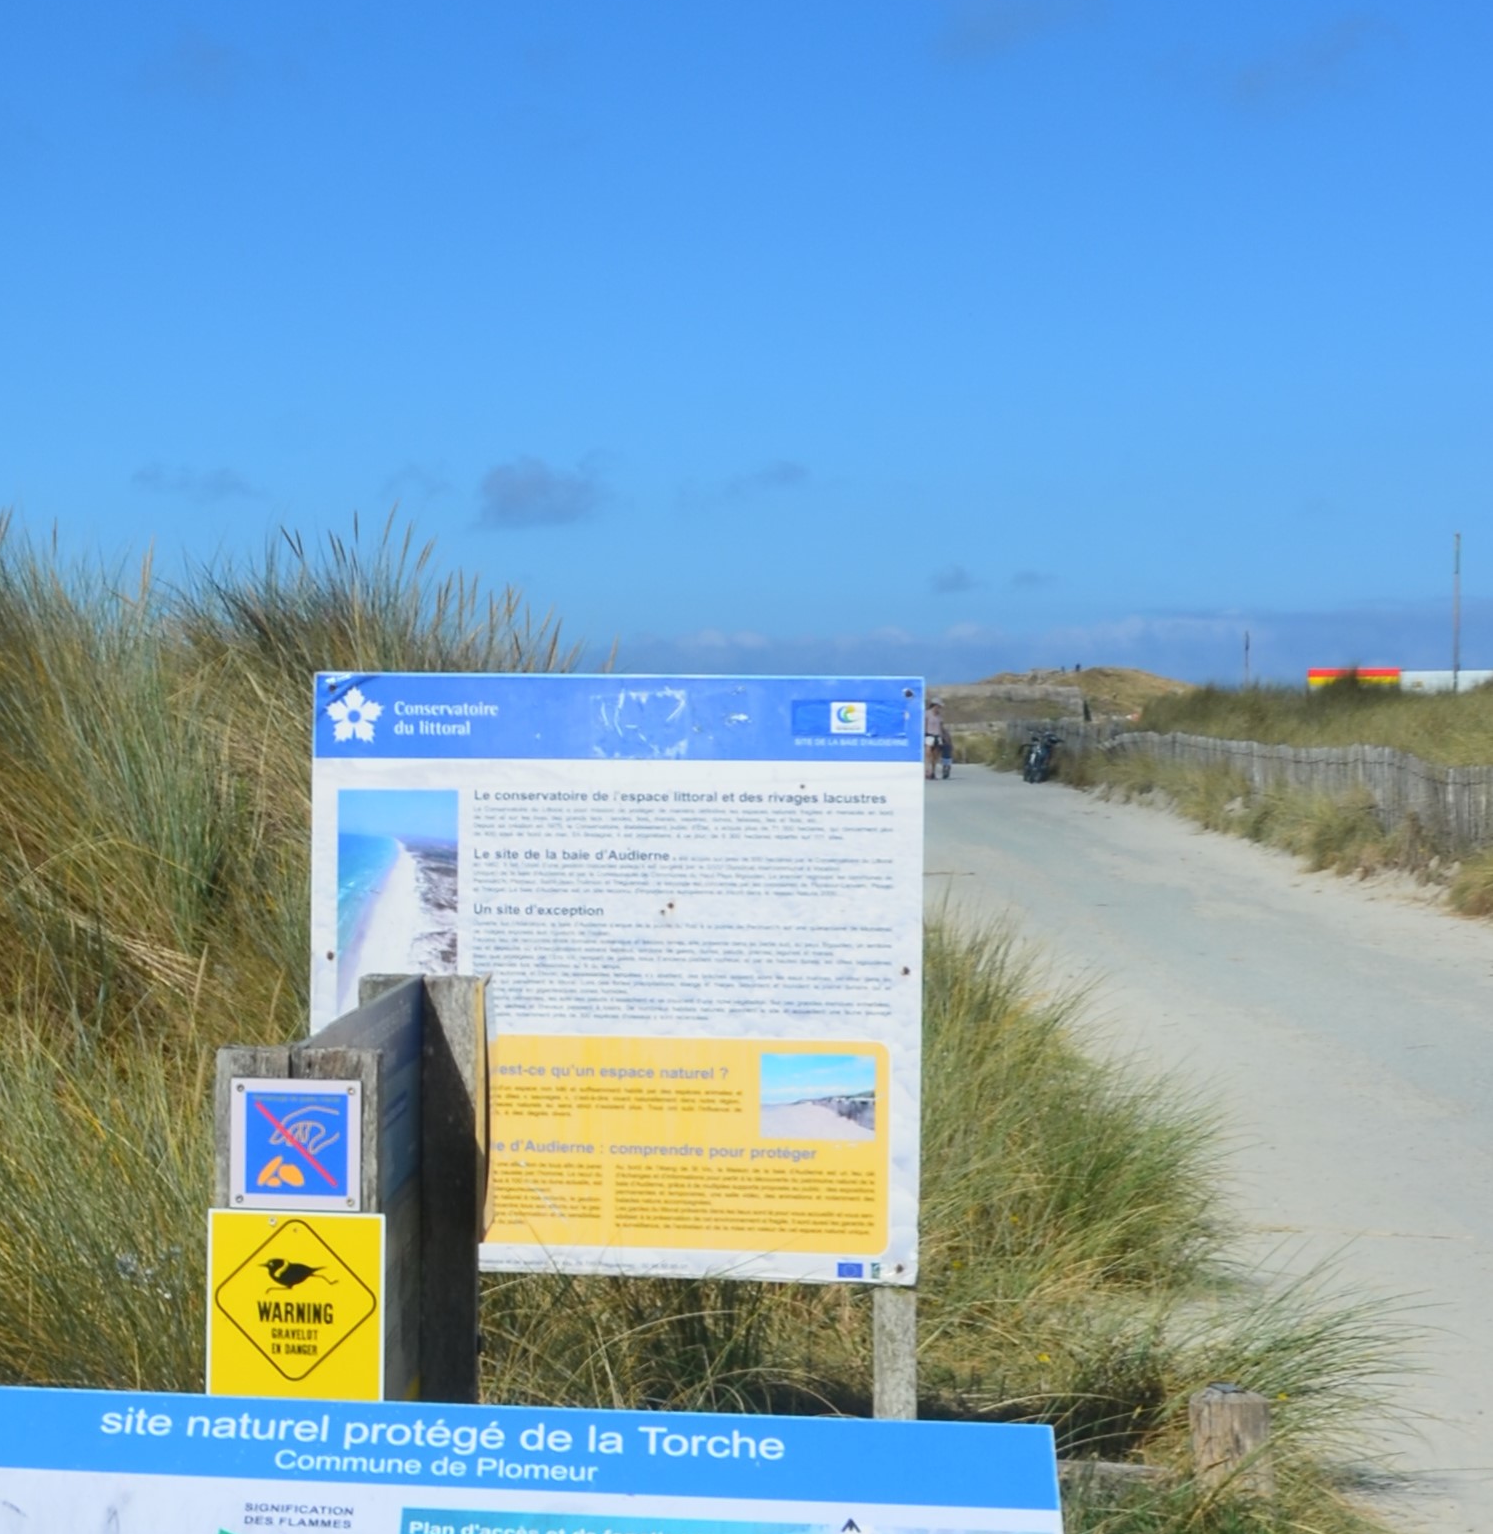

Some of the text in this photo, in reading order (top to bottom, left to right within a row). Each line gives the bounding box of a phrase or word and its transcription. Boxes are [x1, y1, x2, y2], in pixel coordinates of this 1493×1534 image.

[394, 701, 498, 716] Conservatoire
[394, 720, 470, 735] du littoral
[474, 789, 490, 800] Le
[494, 791, 588, 801] conservatoire
[592, 791, 608, 801] de
[674, 791, 717, 802] littoral
[721, 792, 734, 802] et
[738, 792, 763, 803] des
[767, 793, 818, 806] rivages
[823, 792, 887, 804] lacustres
[473, 848, 490, 859] Le
[495, 849, 518, 859] site
[524, 849, 540, 860] de
[545, 849, 557, 860] la
[562, 850, 589, 860] baie
[594, 850, 669, 861] d'Audierne
[473, 903, 604, 917] Un site d'exception
[551, 1066, 595, 1078] qu'un
[599, 1067, 655, 1079] espace
[659, 1067, 714, 1079] naturel
[510, 1139, 595, 1154] d'Audierne
[608, 1144, 703, 1157] comprendre
[708, 1147, 744, 1159] pour
[749, 1148, 816, 1161] protéger
[258, 1302, 333, 1324] WARNING
[272, 1328, 318, 1340] GRAVELOT
[272, 1343, 317, 1354] EN DANGER
[100, 1407, 785, 1460] site naturel protégé de la Torche
[274, 1448, 598, 1482] Commune de Plomeur
[245, 1503, 354, 1515] SIGNIFICATION
[244, 1515, 351, 1529] DES FLAMMES
